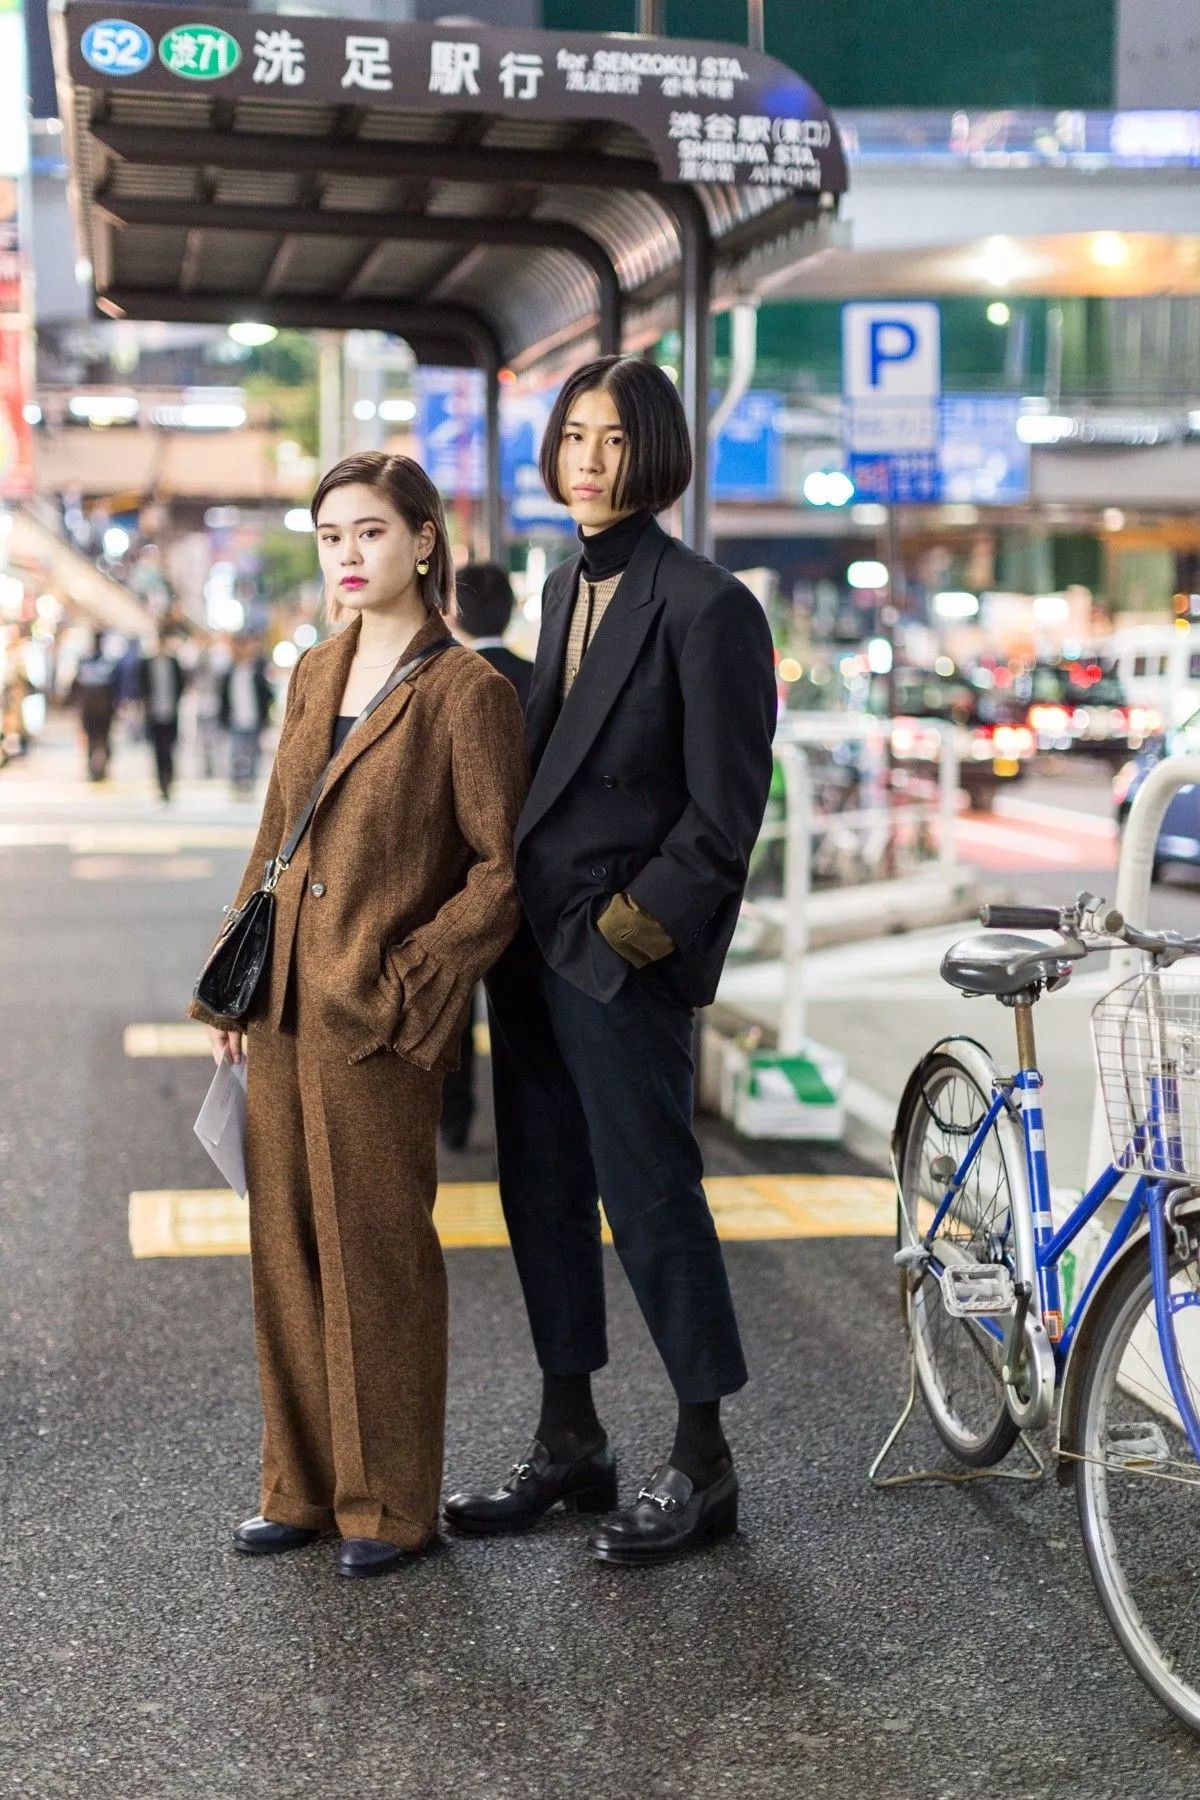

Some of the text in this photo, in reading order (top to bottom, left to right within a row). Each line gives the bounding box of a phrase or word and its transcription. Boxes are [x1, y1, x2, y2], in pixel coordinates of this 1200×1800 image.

[92, 28, 142, 66] 52
[169, 32, 229, 71] 渋71
[252, 29, 544, 99] 洗足駅行
[556, 48, 588, 69] for
[592, 50, 698, 78] SENZOKU
[677, 139, 769, 163] SHIBUYA
[870, 320, 918, 388] P
